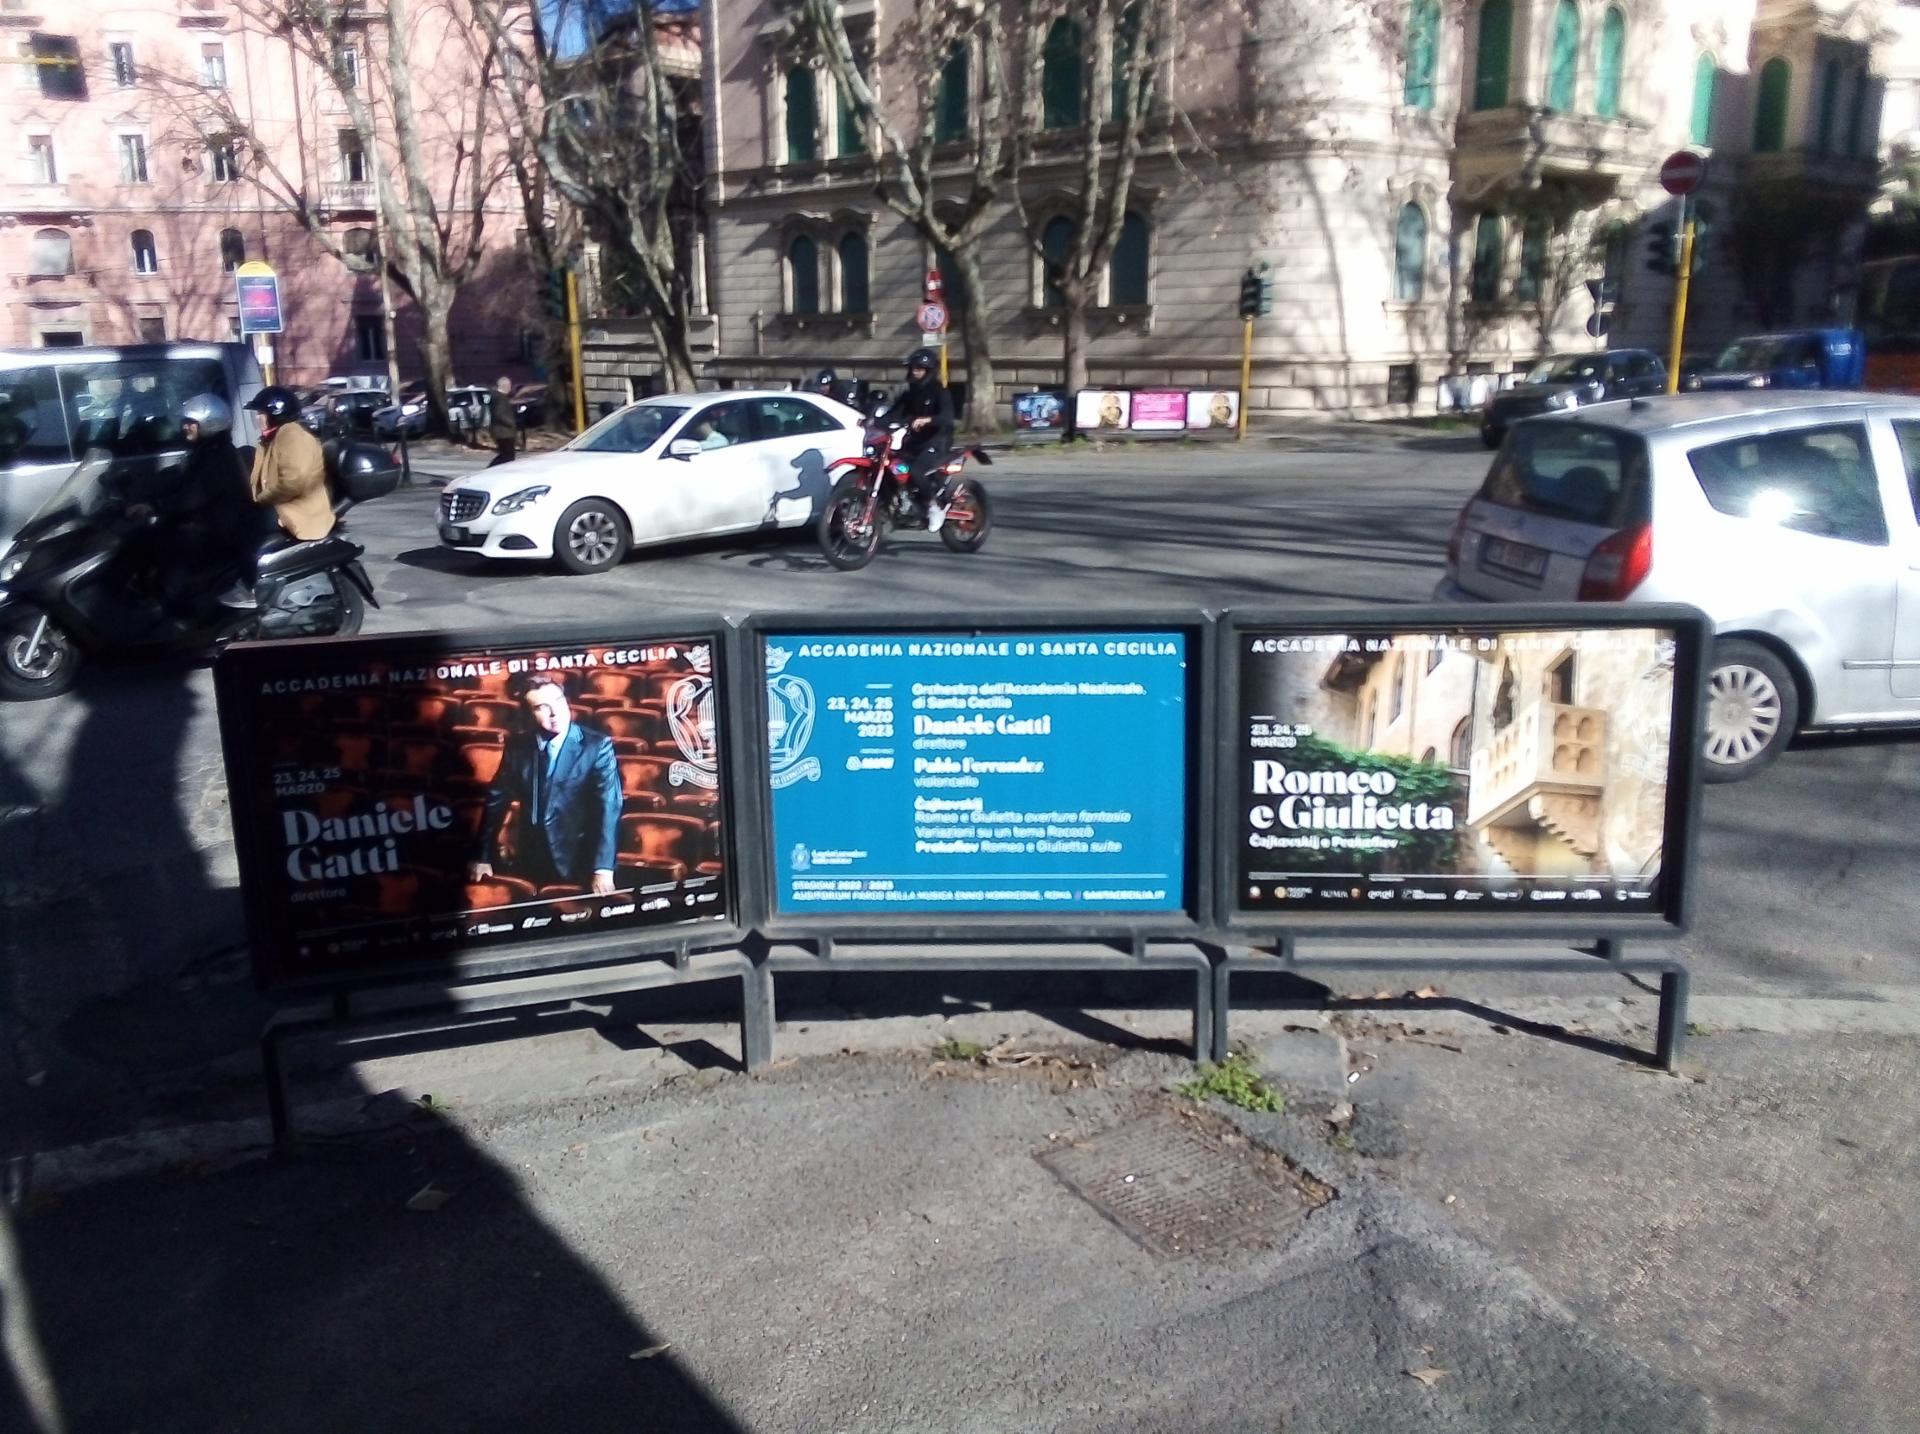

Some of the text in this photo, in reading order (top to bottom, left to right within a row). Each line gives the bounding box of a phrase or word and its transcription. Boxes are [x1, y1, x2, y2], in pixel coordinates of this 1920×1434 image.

[798, 641, 1177, 658] ACCADEMIA NAZIONALE DI SANTA CECILIA
[261, 646, 678, 695] ACCADEMIA NAZIONALE DI SANTA CECILIA
[874, 696, 894, 710] 25
[912, 696, 1012, 709] di Santa Cecilia
[844, 710, 894, 724] MARZO
[913, 714, 1051, 736] Daniele Gatti
[857, 723, 894, 738] 2023
[912, 737, 968, 751] direttore
[1250, 736, 1297, 749] MARZO
[913, 756, 962, 774] Pablo
[323, 768, 341, 780] 25
[1252, 759, 1397, 796] Romeo
[275, 782, 326, 798] MARZO
[283, 793, 453, 846] Daniele
[914, 809, 959, 824] Romeo
[970, 809, 1024, 824] Giulietta
[1249, 795, 1455, 830] e Giulietta
[286, 838, 400, 882] Gatti
[291, 887, 347, 903] direttore
